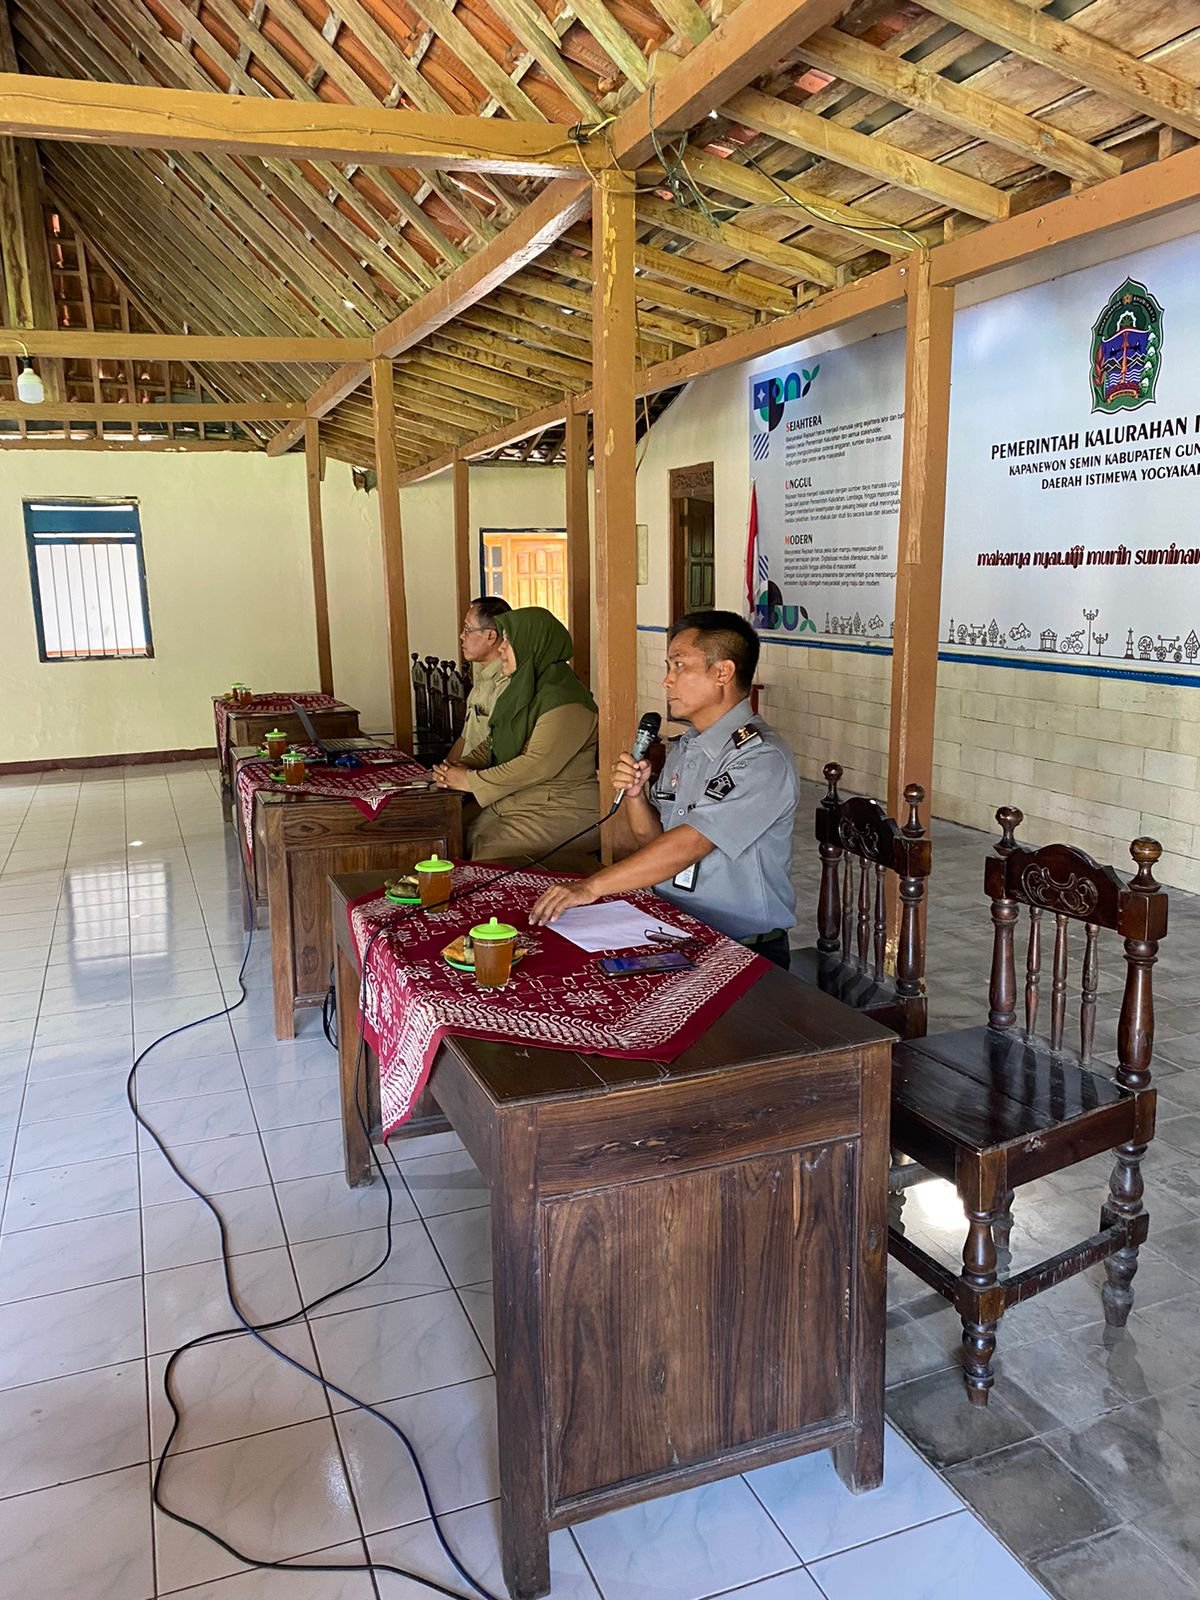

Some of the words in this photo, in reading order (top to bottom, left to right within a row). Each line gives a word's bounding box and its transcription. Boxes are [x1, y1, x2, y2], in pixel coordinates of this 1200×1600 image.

[785, 414, 822, 432] SEJAHTERA
[991, 433, 1079, 459] PEMERINTAH
[1085, 416, 1187, 447] KALURAHAN
[1009, 459, 1066, 476] KAPANEWON
[1069, 455, 1101, 469] SEMIN
[1104, 446, 1171, 466] KABUPATEN
[1175, 442, 1200, 457] GUN
[784, 477, 812, 490] UNGGUL
[1041, 474, 1082, 489] DAERAH
[1085, 470, 1137, 485] ISTIMEWA
[784, 535, 813, 545] MODERN
[977, 549, 1031, 569] makarya
